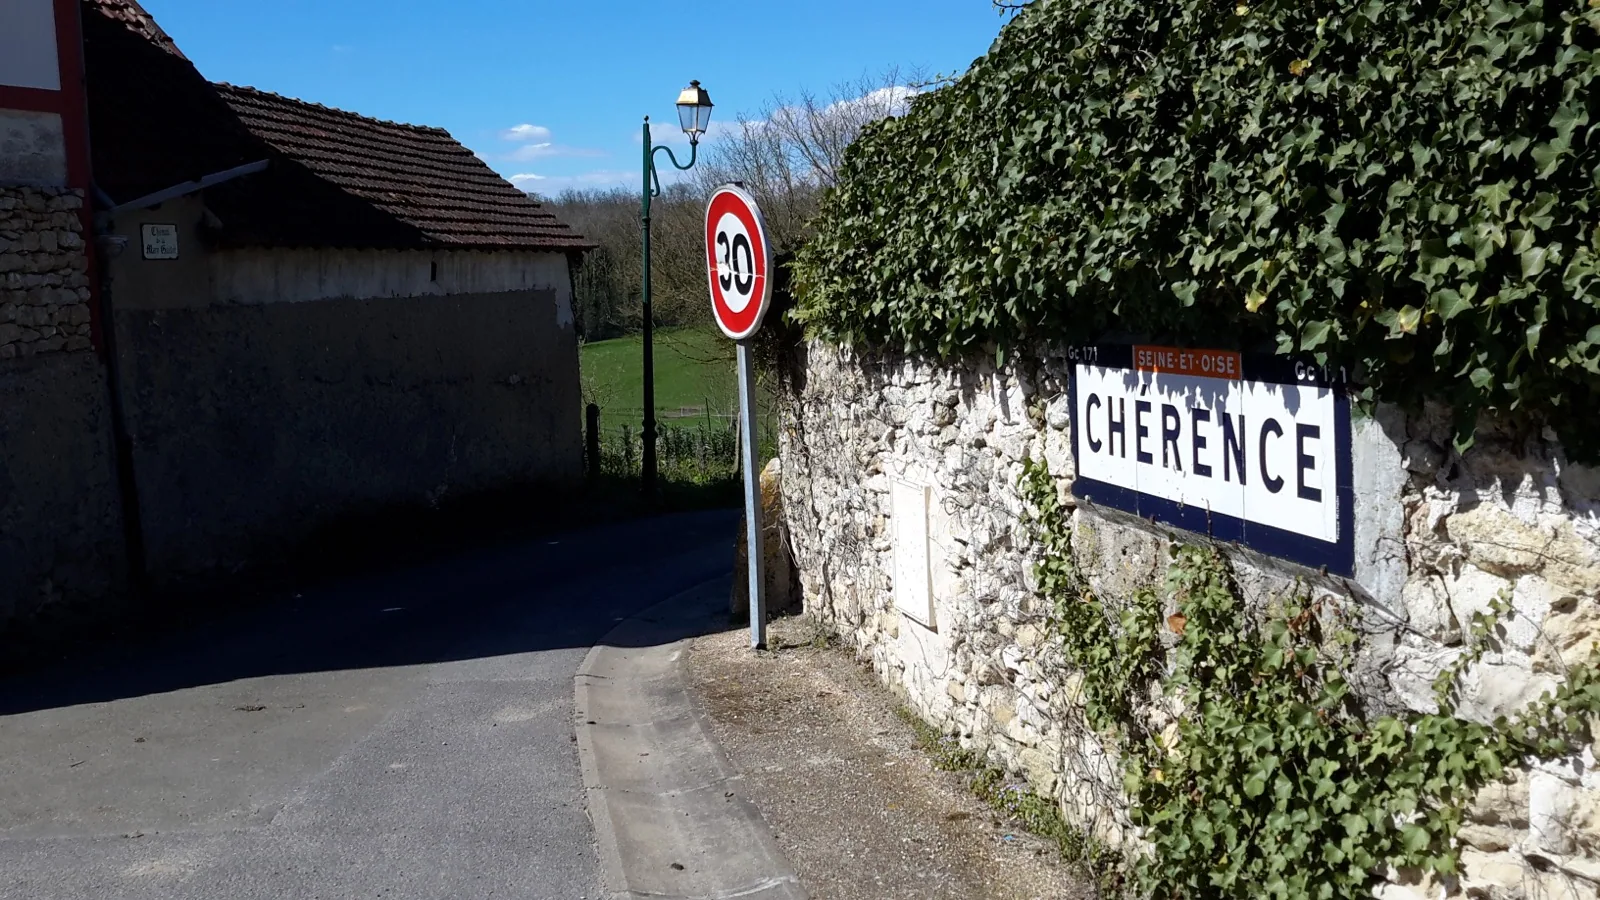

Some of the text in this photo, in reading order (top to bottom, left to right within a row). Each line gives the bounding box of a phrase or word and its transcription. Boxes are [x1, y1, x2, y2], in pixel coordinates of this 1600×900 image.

[717, 231, 753, 296] 30
[1082, 346, 1098, 362] 171
[1323, 364, 1347, 384] 11
[1086, 384, 1322, 503] CHÉRENCE
